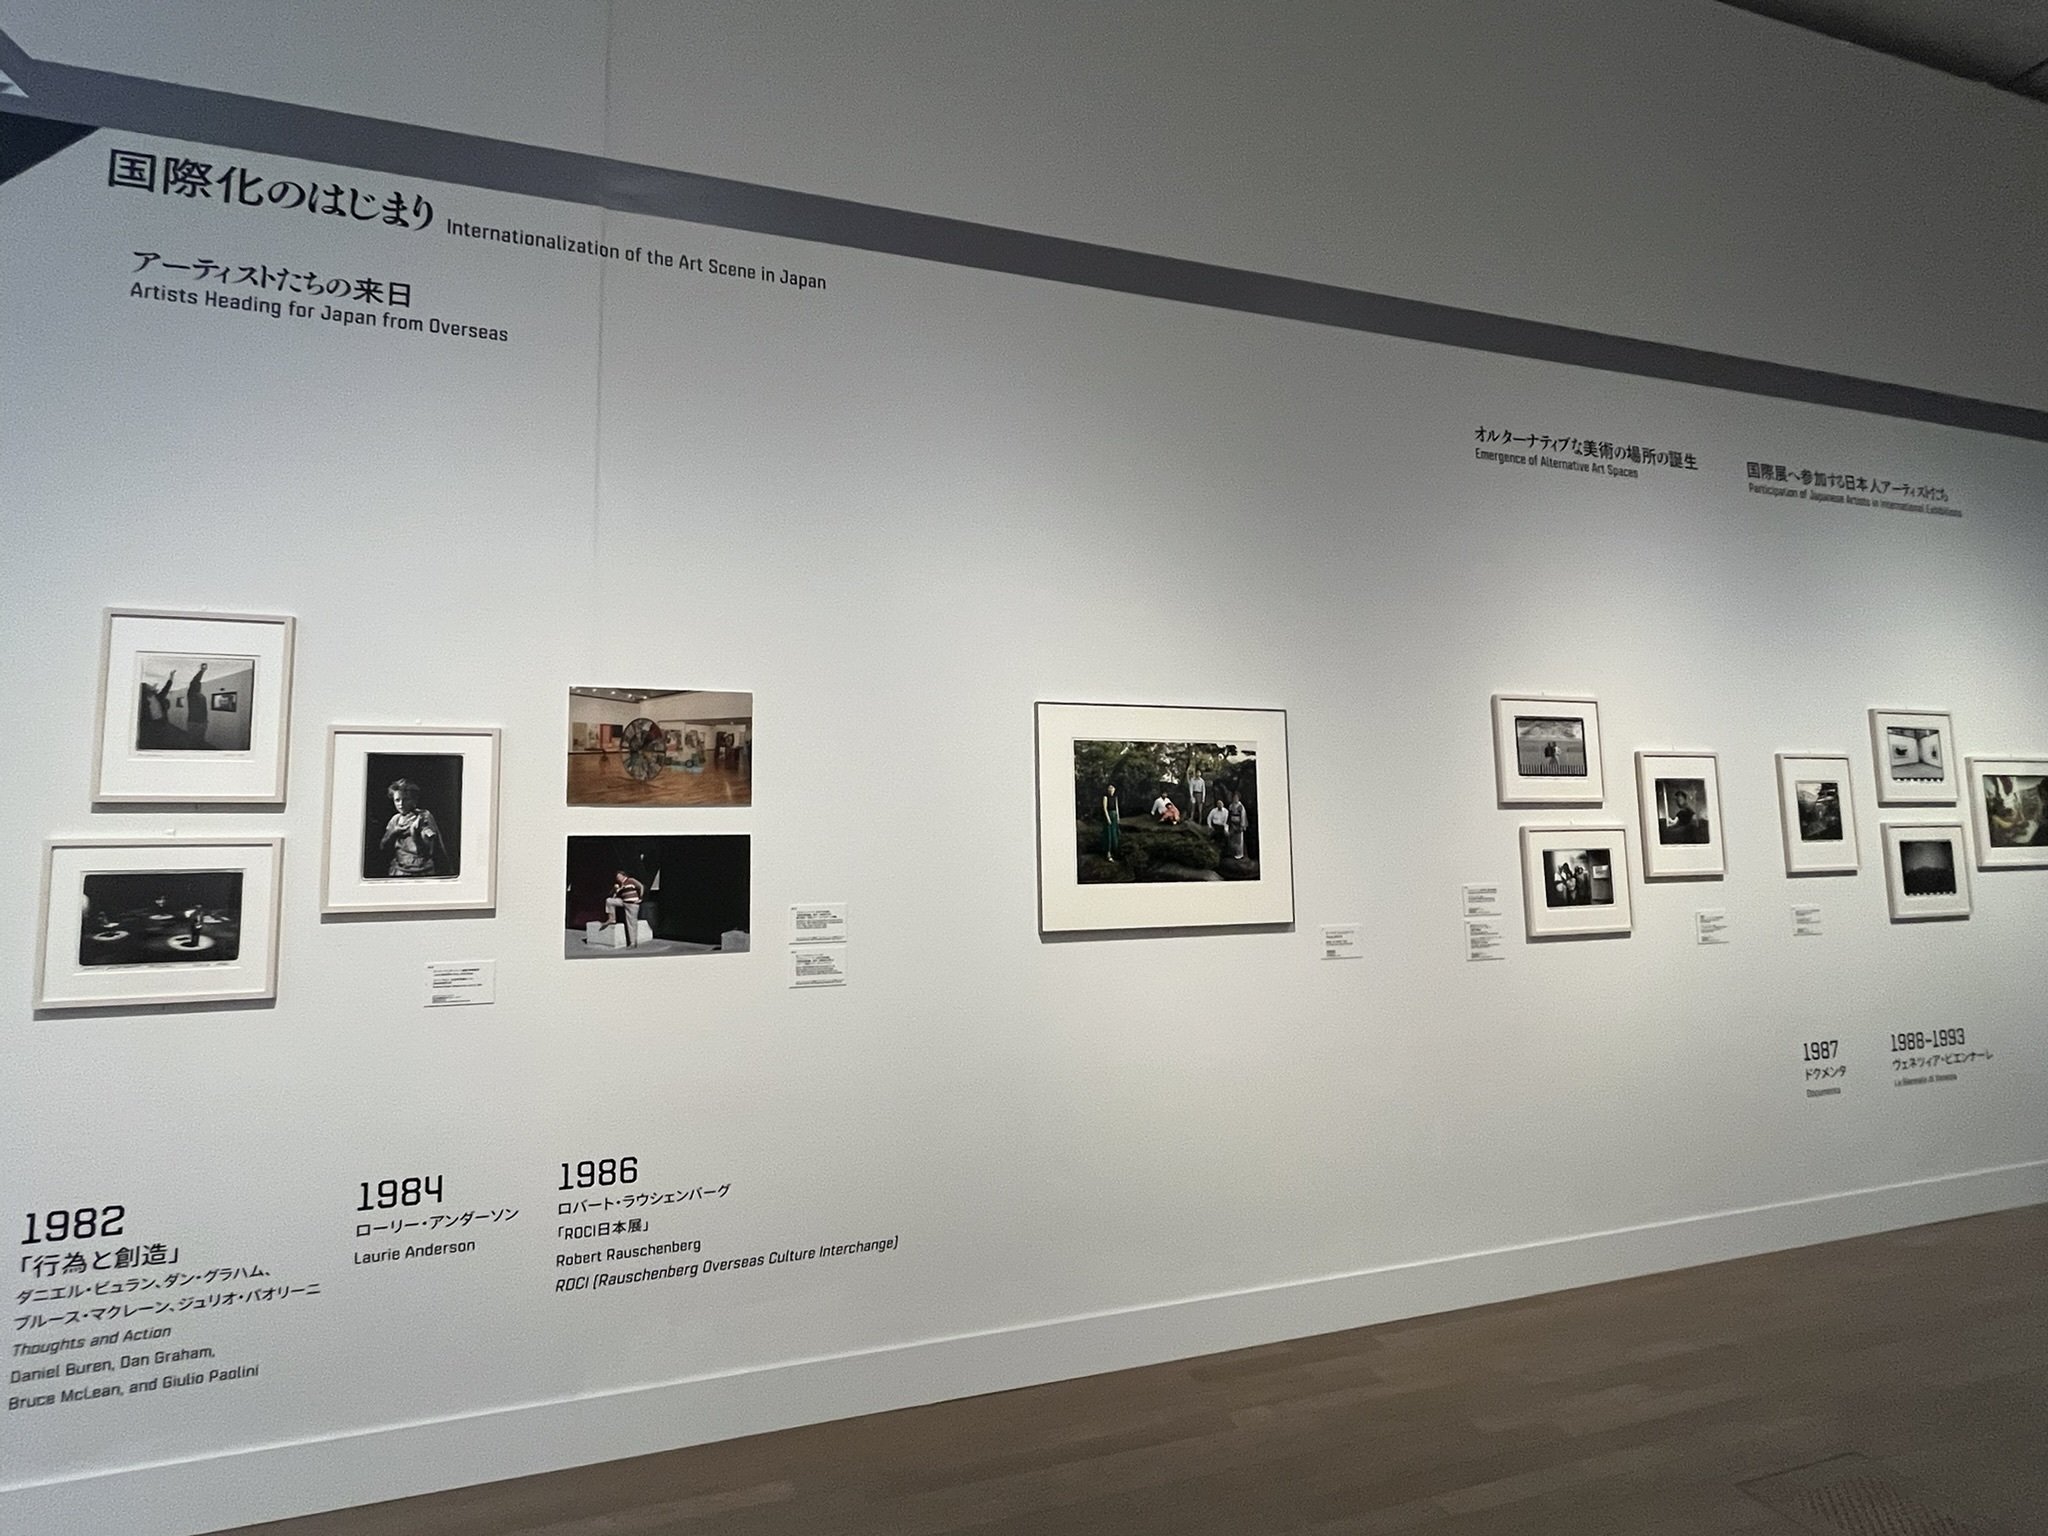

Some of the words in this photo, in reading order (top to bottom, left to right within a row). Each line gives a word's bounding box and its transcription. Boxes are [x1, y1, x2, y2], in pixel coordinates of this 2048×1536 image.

[108, 149, 434, 231] 国際化のはじまり
[446, 219, 619, 260] Internationalization
[625, 248, 641, 263] of
[647, 250, 674, 268] the
[678, 254, 703, 272] Art
[708, 259, 756, 280] Scene
[761, 266, 775, 282] in
[779, 269, 827, 290] Japan
[132, 251, 411, 308] アーティストたちの来日
[130, 282, 198, 305] Artists
[205, 290, 281, 318] Heading
[289, 301, 315, 318] for
[321, 305, 376, 326] Japan
[383, 312, 423, 332] from
[429, 318, 508, 342] Overseas
[1474, 426, 1698, 471] オルターナティブな美術の場所の誕生
[1475, 448, 1526, 465] Emergence
[1529, 454, 1538, 466] of
[1540, 457, 1589, 473] Alternative
[1591, 462, 1604, 474] Art
[1608, 464, 1638, 479] Spaces
[1803, 1040, 1839, 1061] 1987
[1891, 1028, 1966, 1052] 1988-1993
[1805, 1065, 1846, 1081] ドクメンタ
[558, 1156, 638, 1191] 1986
[357, 1174, 443, 1211] 1984
[558, 1183, 732, 1215] ロバート・ラウシェンバーグ
[21, 1205, 125, 1245] 1982
[356, 1208, 520, 1237] ローリー・アンダーソン
[558, 1218, 649, 1240] 「ROCI日本展」
[20, 1243, 179, 1278] 「行為と創造」
[354, 1247, 400, 1265] Laurie
[405, 1241, 476, 1259] Anderson
[555, 1276, 589, 1292] ROCI
[592, 1263, 699, 1290] (Rauschenberg
[702, 1255, 764, 1274] Overseas
[768, 1248, 815, 1265] Culture
[819, 1235, 899, 1258] Interchange)
[556, 1250, 601, 1267] Robert
[606, 1239, 701, 1261] Rauschenberg
[12, 1336, 85, 1357] Thoughts
[90, 1331, 118, 1348] and
[122, 1326, 172, 1343] Action
[10, 1363, 60, 1384] Daniel
[65, 1359, 115, 1377] Buren,
[120, 1354, 150, 1369] Dan
[154, 1346, 215, 1365] Graham,
[8, 1393, 55, 1411] Bruce
[60, 1385, 125, 1403] McLean,
[129, 1379, 158, 1394] and
[162, 1372, 204, 1389] Giulio
[209, 1364, 260, 1383] Paolini
